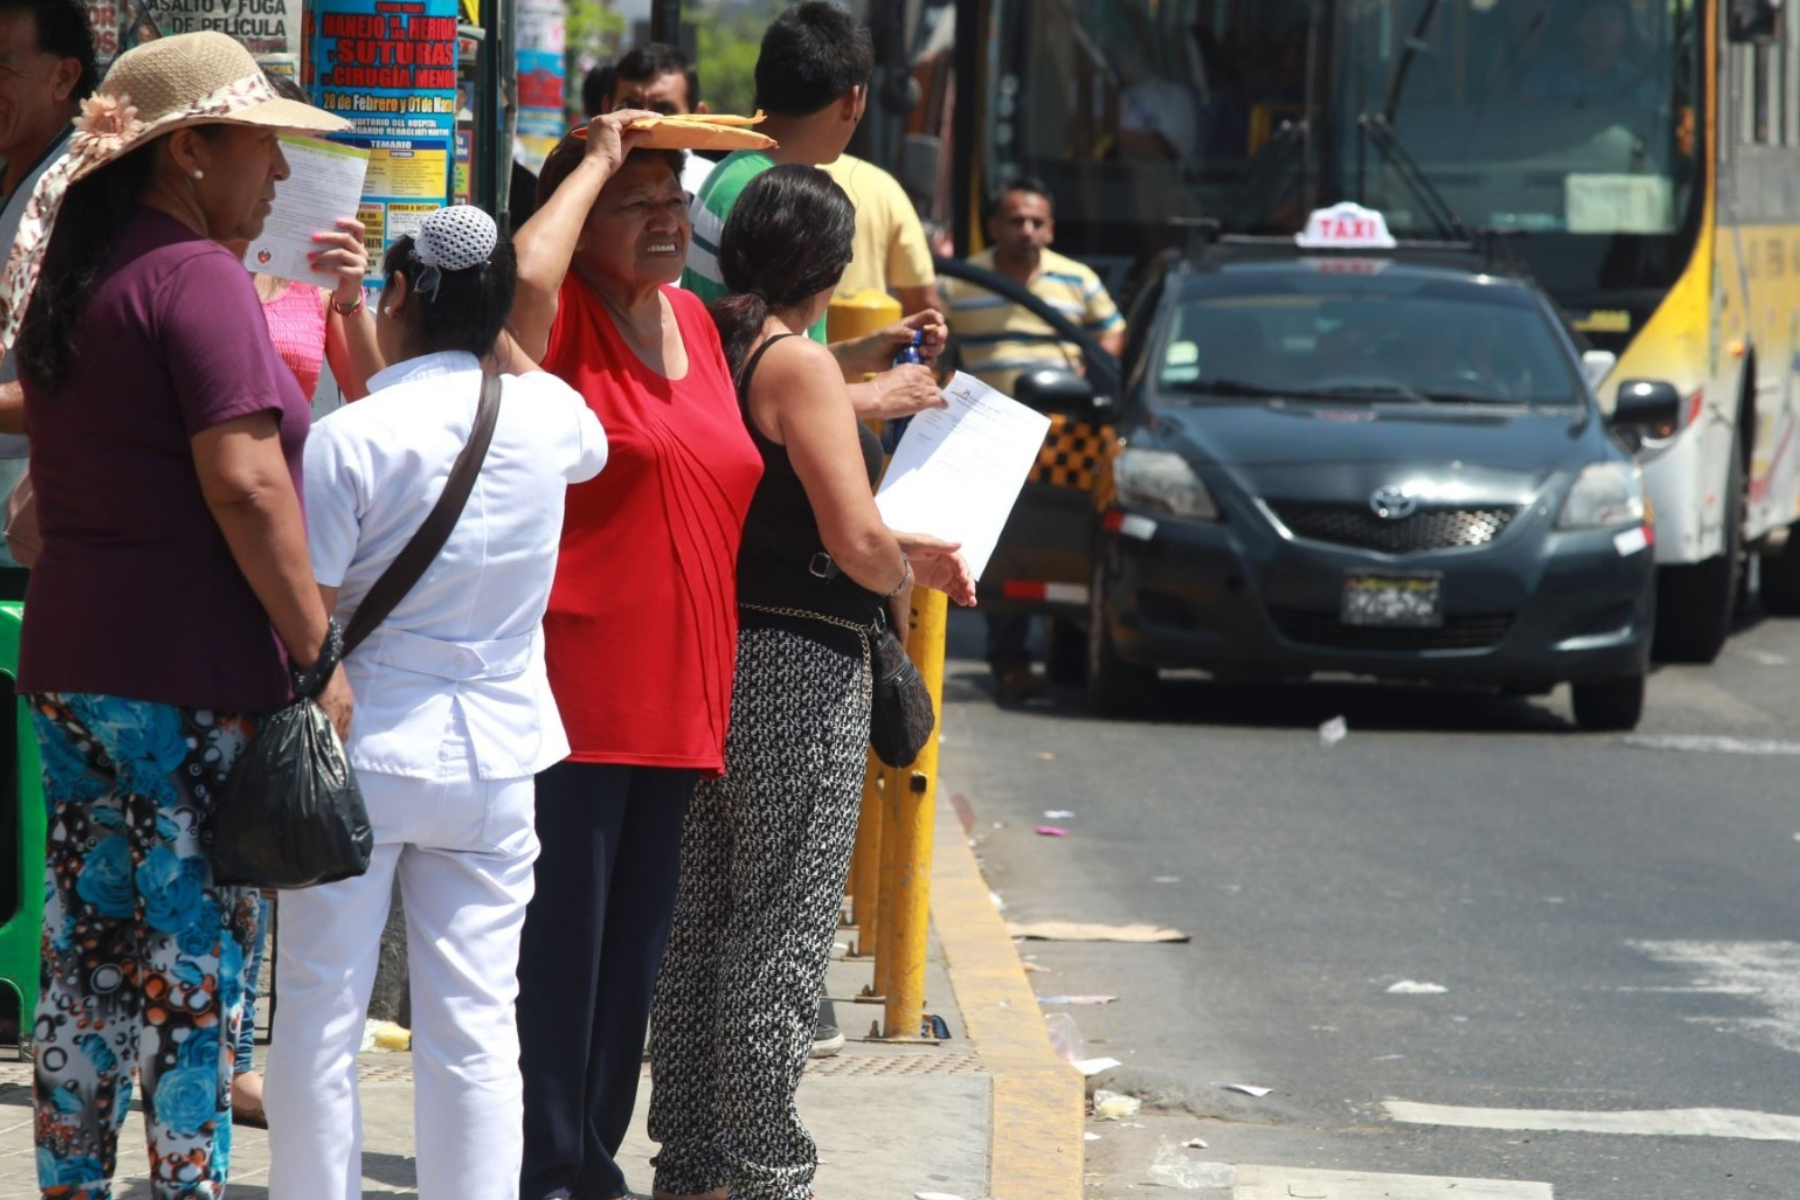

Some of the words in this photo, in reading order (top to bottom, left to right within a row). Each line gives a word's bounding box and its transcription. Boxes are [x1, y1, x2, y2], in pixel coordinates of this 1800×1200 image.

[148, 0, 213, 15] ASALTO
[222, 0, 232, 15] Y
[238, 0, 286, 15] FUGA
[172, 17, 193, 33] DE
[202, 14, 286, 36] PELÍCULA
[323, 13, 385, 38] MANEJO
[337, 40, 454, 66] SUTURAS
[333, 65, 411, 87] CIRUGÍA
[323, 92, 336, 109] 28
[338, 93, 351, 109] de
[353, 94, 399, 110] Febrero
[400, 98, 408, 113] y
[408, 96, 420, 112] 01
[349, 126, 384, 135] DGARDO
[371, 140, 412, 149] TEMARIO
[1320, 219, 1376, 239] TAXI
